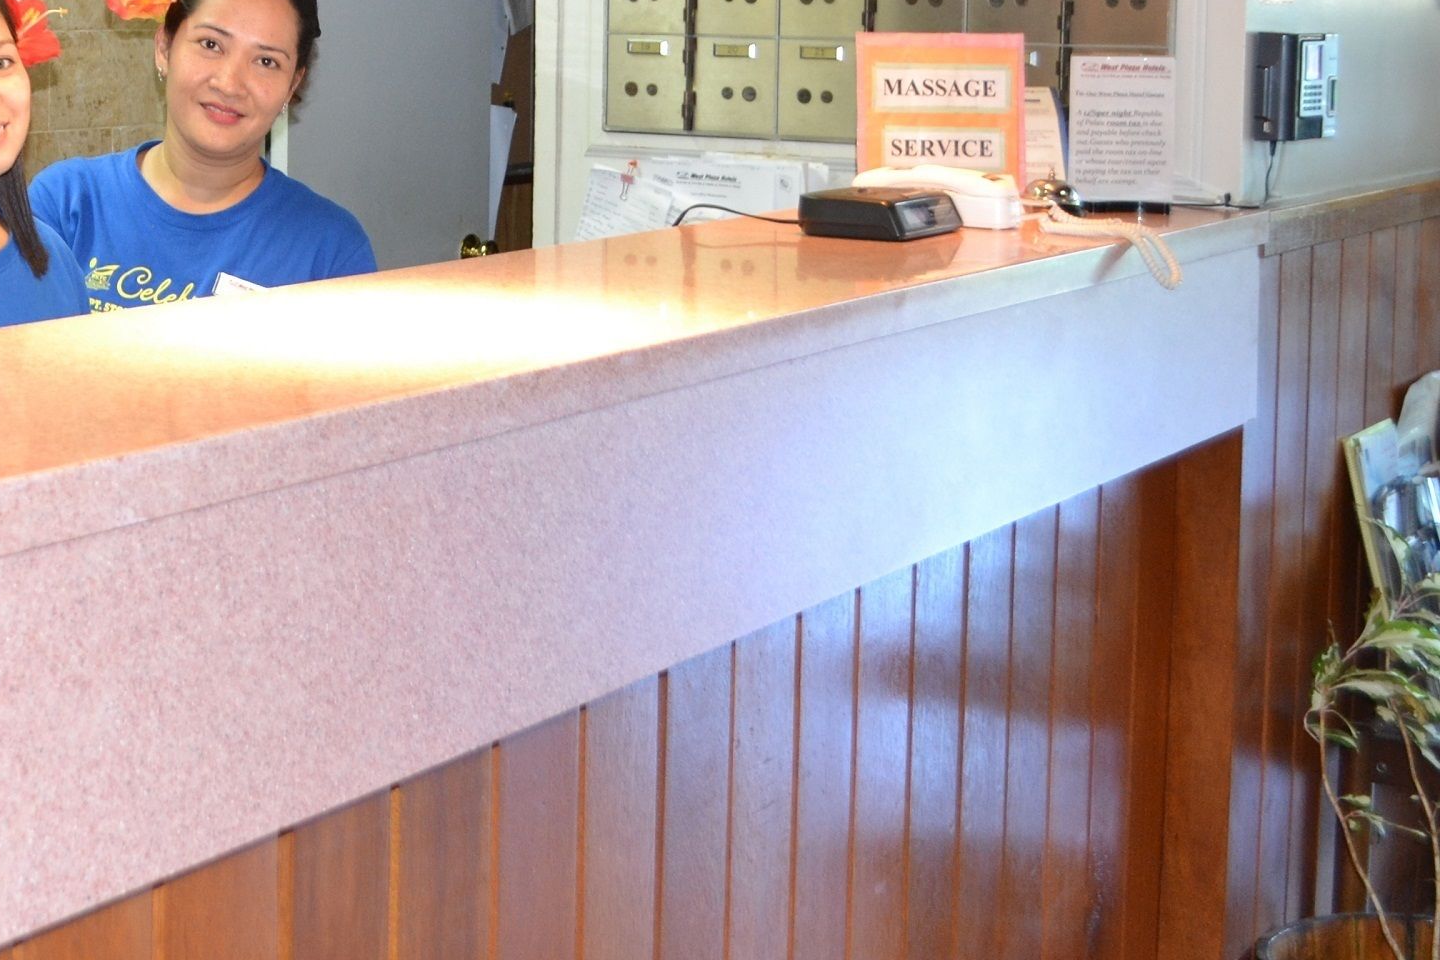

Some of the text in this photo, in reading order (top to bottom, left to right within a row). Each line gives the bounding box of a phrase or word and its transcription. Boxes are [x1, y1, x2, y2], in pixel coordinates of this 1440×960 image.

[1101, 64, 1165, 73] West Plaza Hotels
[883, 77, 997, 97] MASSAGE
[1111, 109, 1132, 118] night
[891, 139, 993, 158] SERVICE
